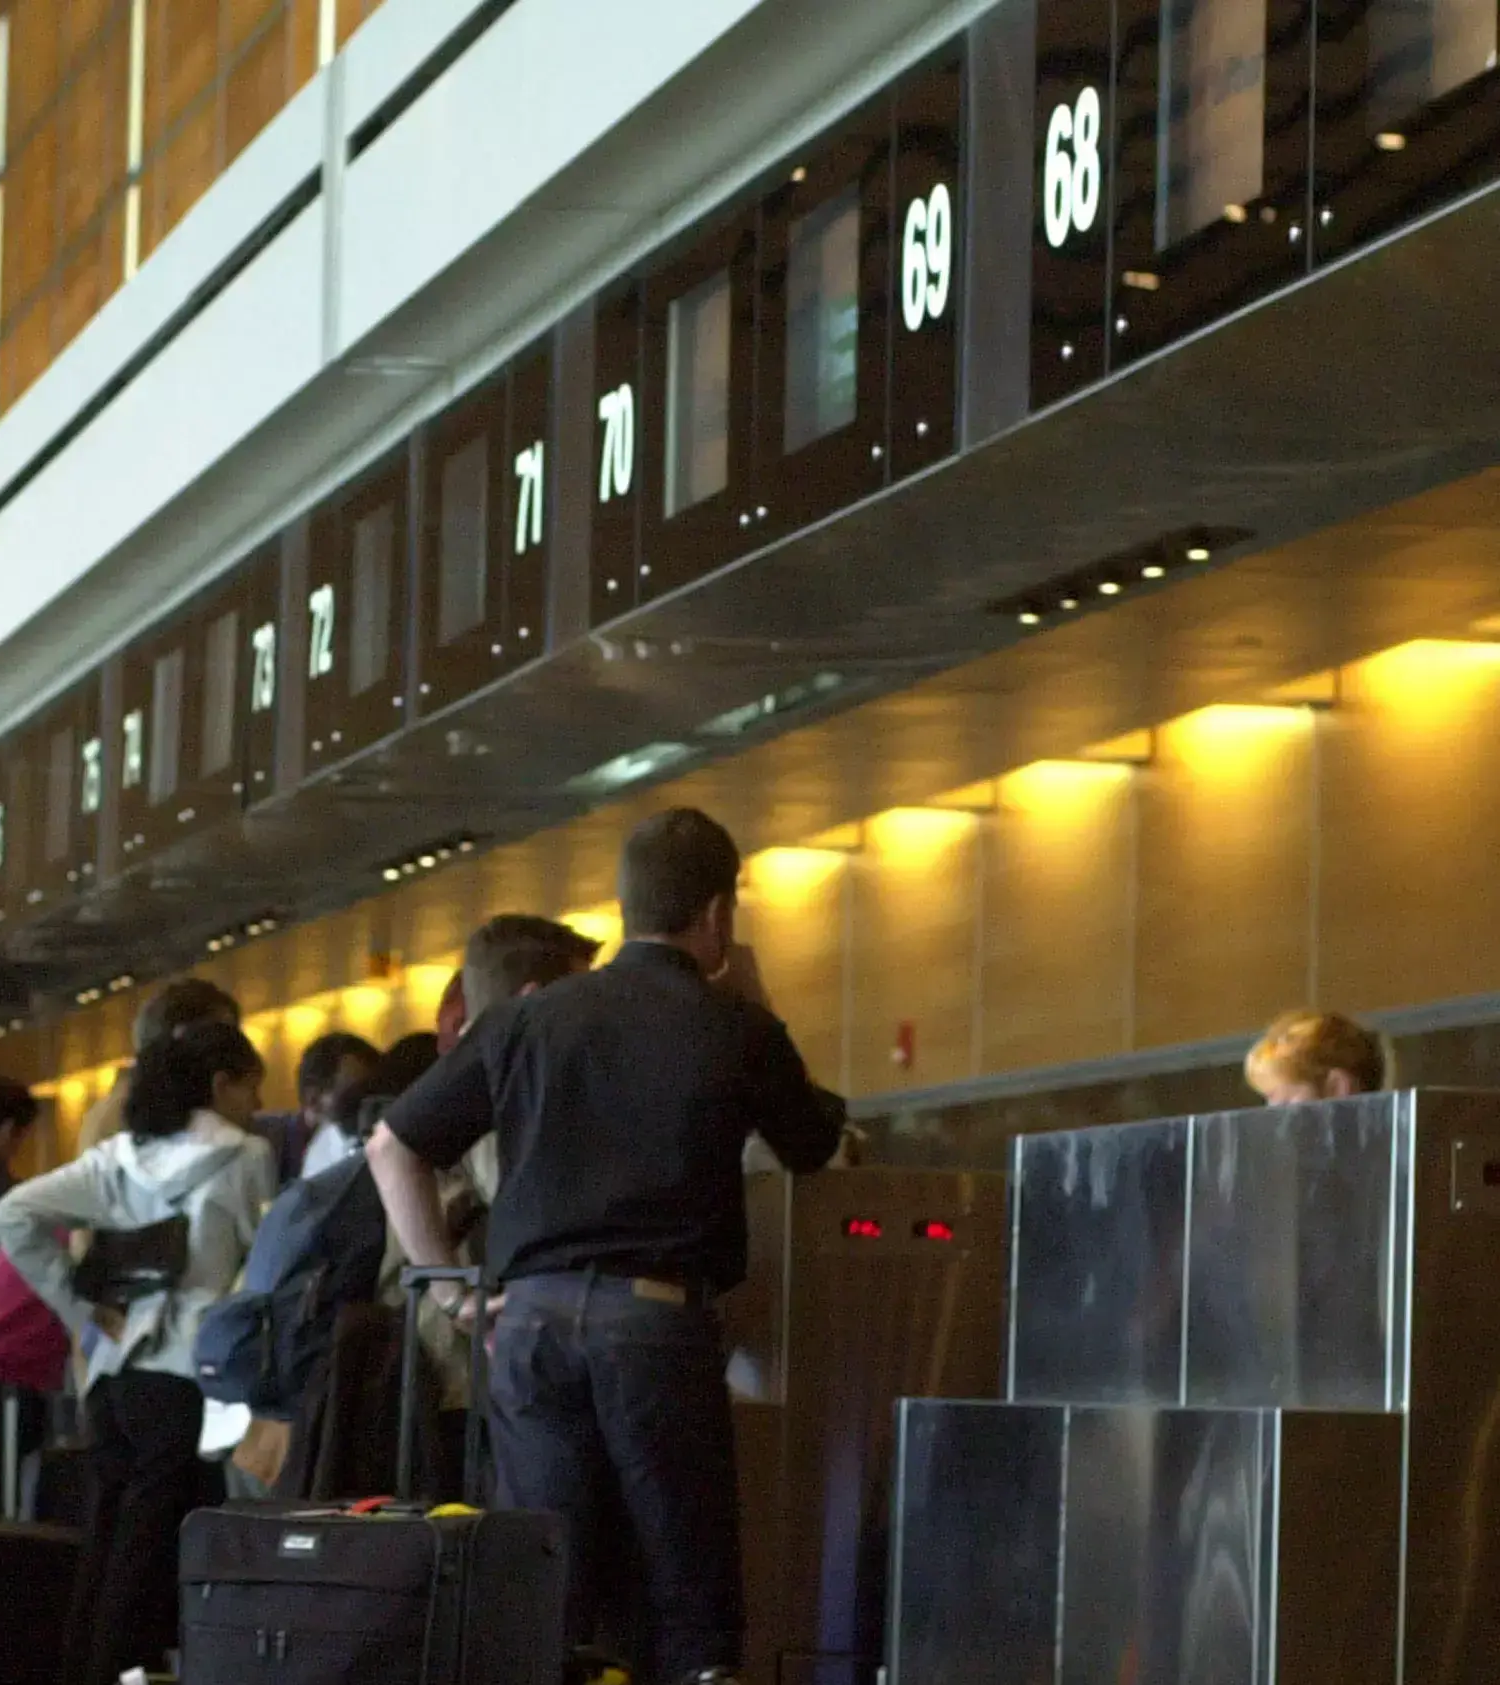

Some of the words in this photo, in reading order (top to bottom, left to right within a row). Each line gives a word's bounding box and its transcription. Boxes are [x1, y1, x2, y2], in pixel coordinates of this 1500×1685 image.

[1043, 86, 1101, 248] 68
[901, 182, 952, 332] 69
[514, 440, 544, 554] 71
[598, 383, 635, 503] 70
